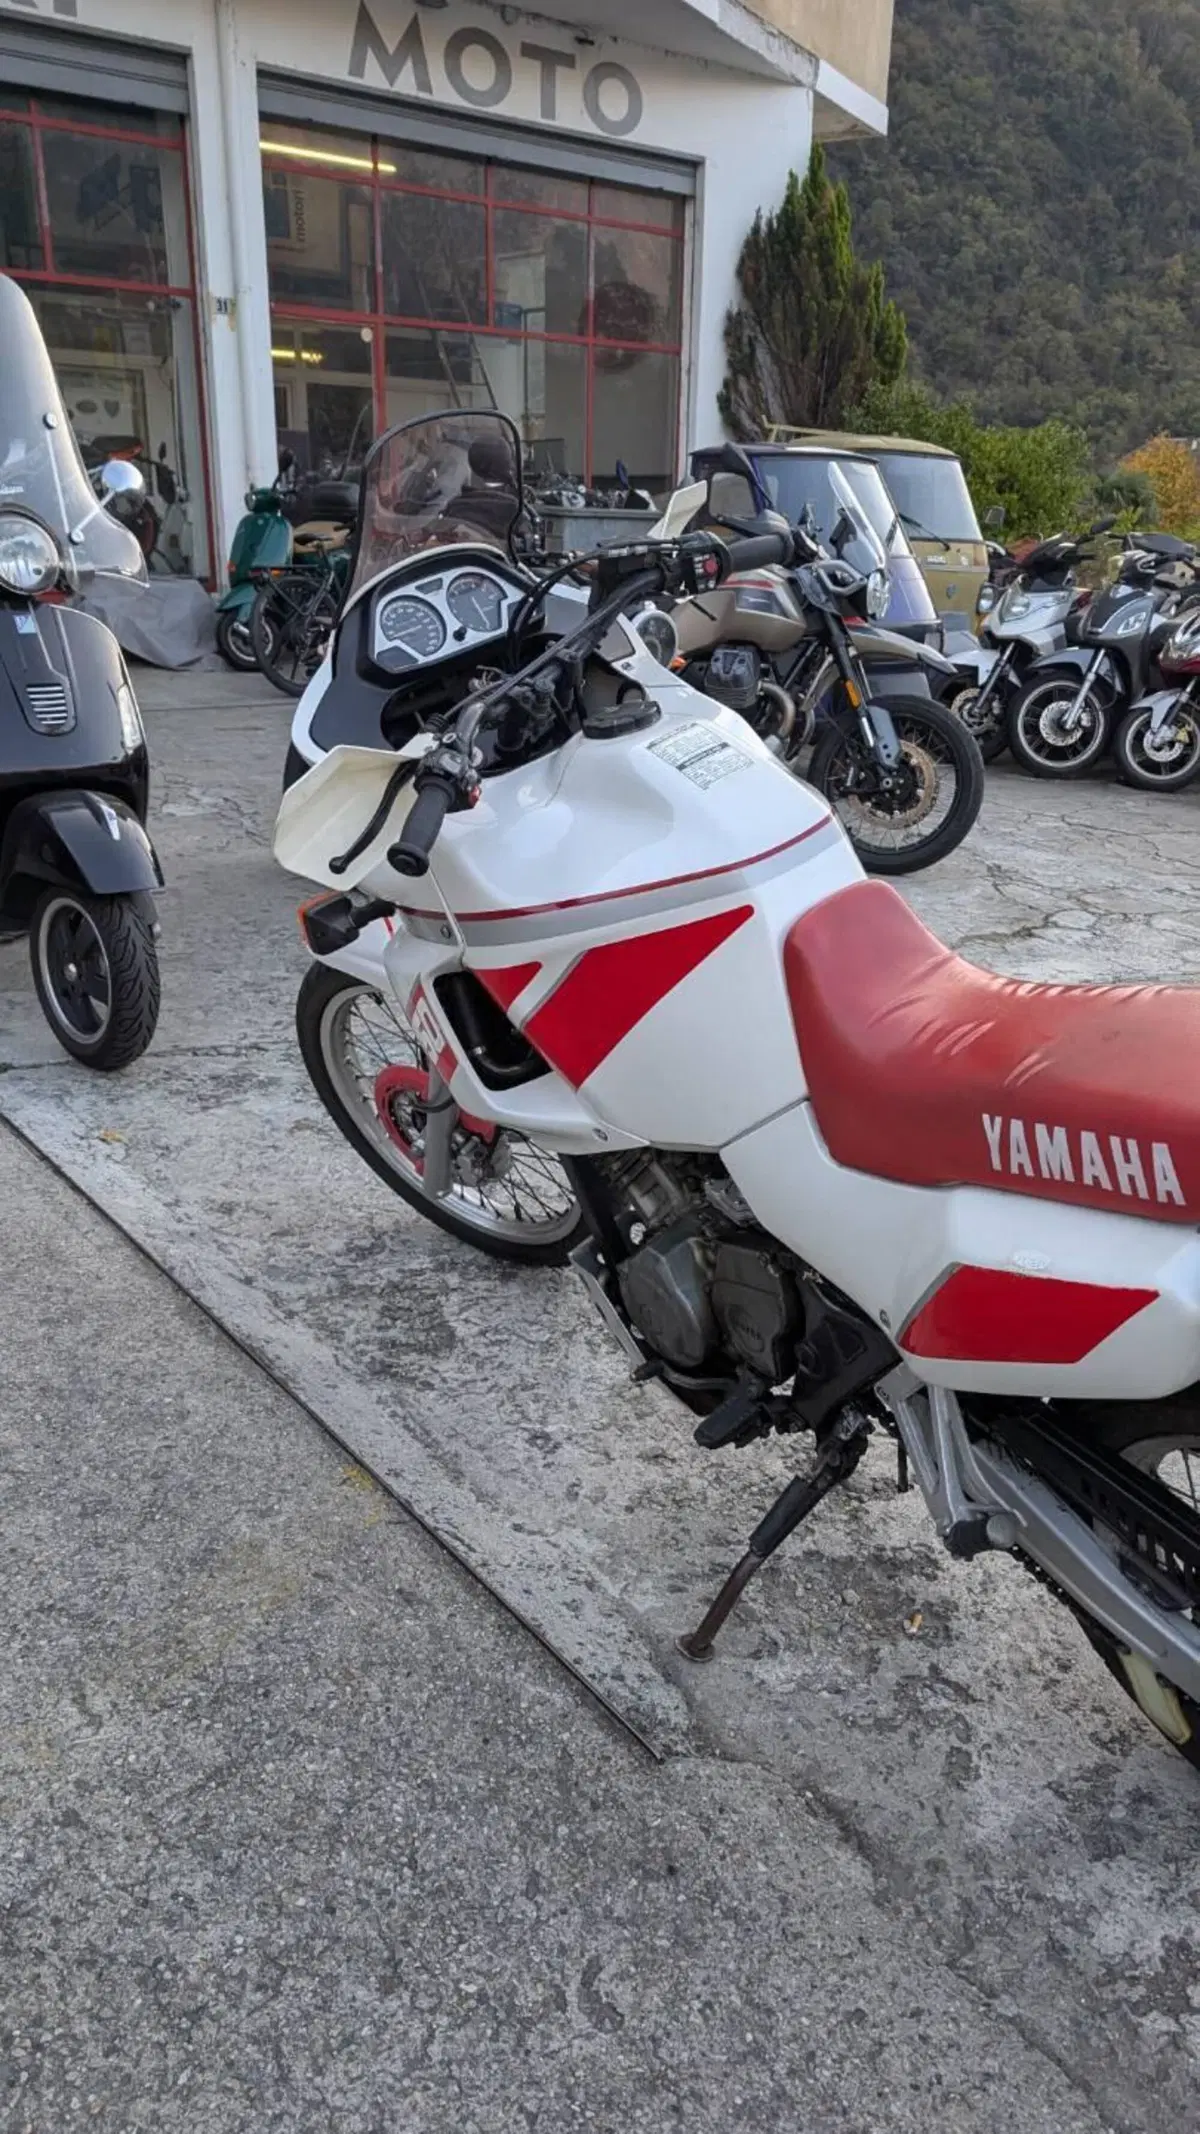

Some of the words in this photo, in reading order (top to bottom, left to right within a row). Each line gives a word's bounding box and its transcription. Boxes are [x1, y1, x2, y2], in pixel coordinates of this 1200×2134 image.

[348, 0, 643, 137] MOTO
[215, 298, 228, 313] 31
[982, 1113, 1187, 1206] YAMAHA
